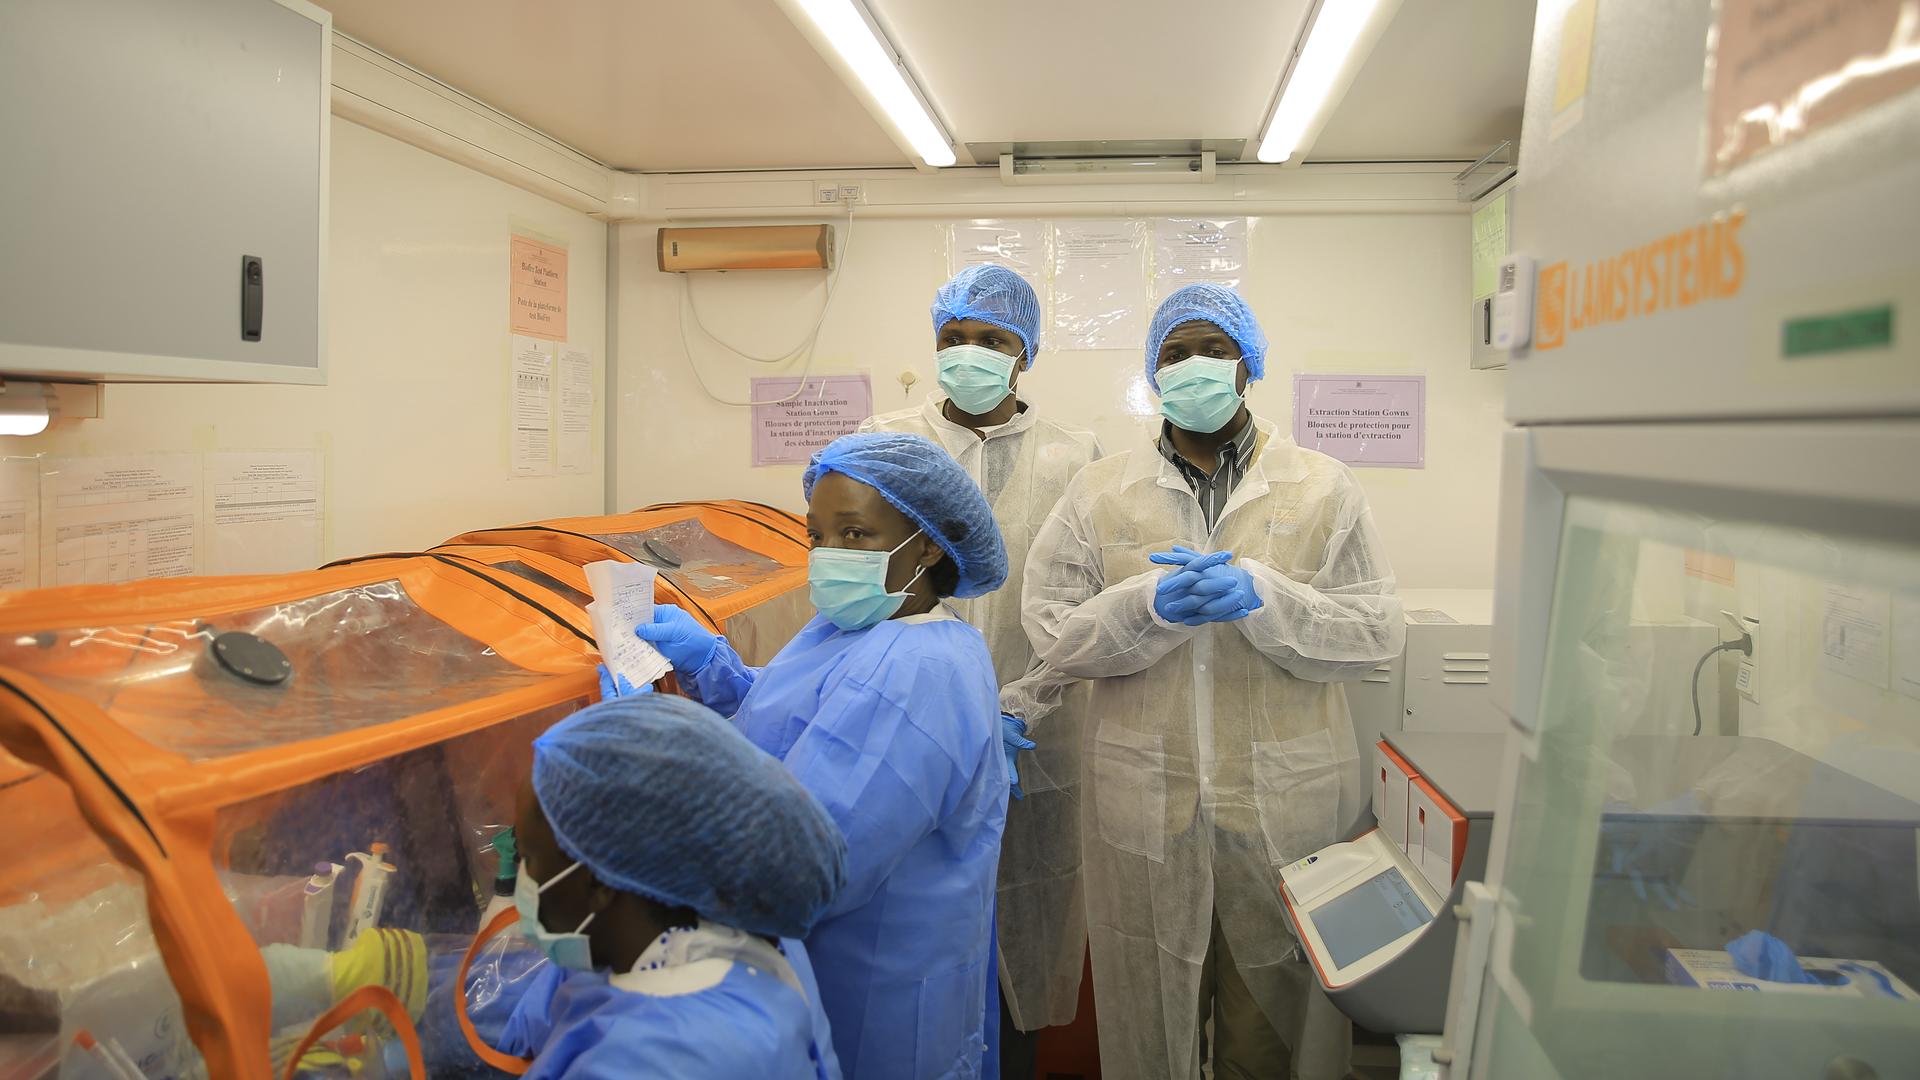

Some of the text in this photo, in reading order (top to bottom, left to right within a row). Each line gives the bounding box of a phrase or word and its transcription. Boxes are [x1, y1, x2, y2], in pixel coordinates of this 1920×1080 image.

[1570, 212, 1746, 330] LAMSYSTEMS
[776, 399, 848, 408] Sample Inactivation
[1309, 408, 1350, 416] Extraction
[1352, 408, 1380, 416] Station
[765, 420, 792, 428] Blouses
[804, 419, 841, 428] protection
[1307, 421, 1337, 429] Blouses
[1349, 421, 1390, 430] protection
[778, 429, 803, 437] station
[784, 439, 797, 447] des
